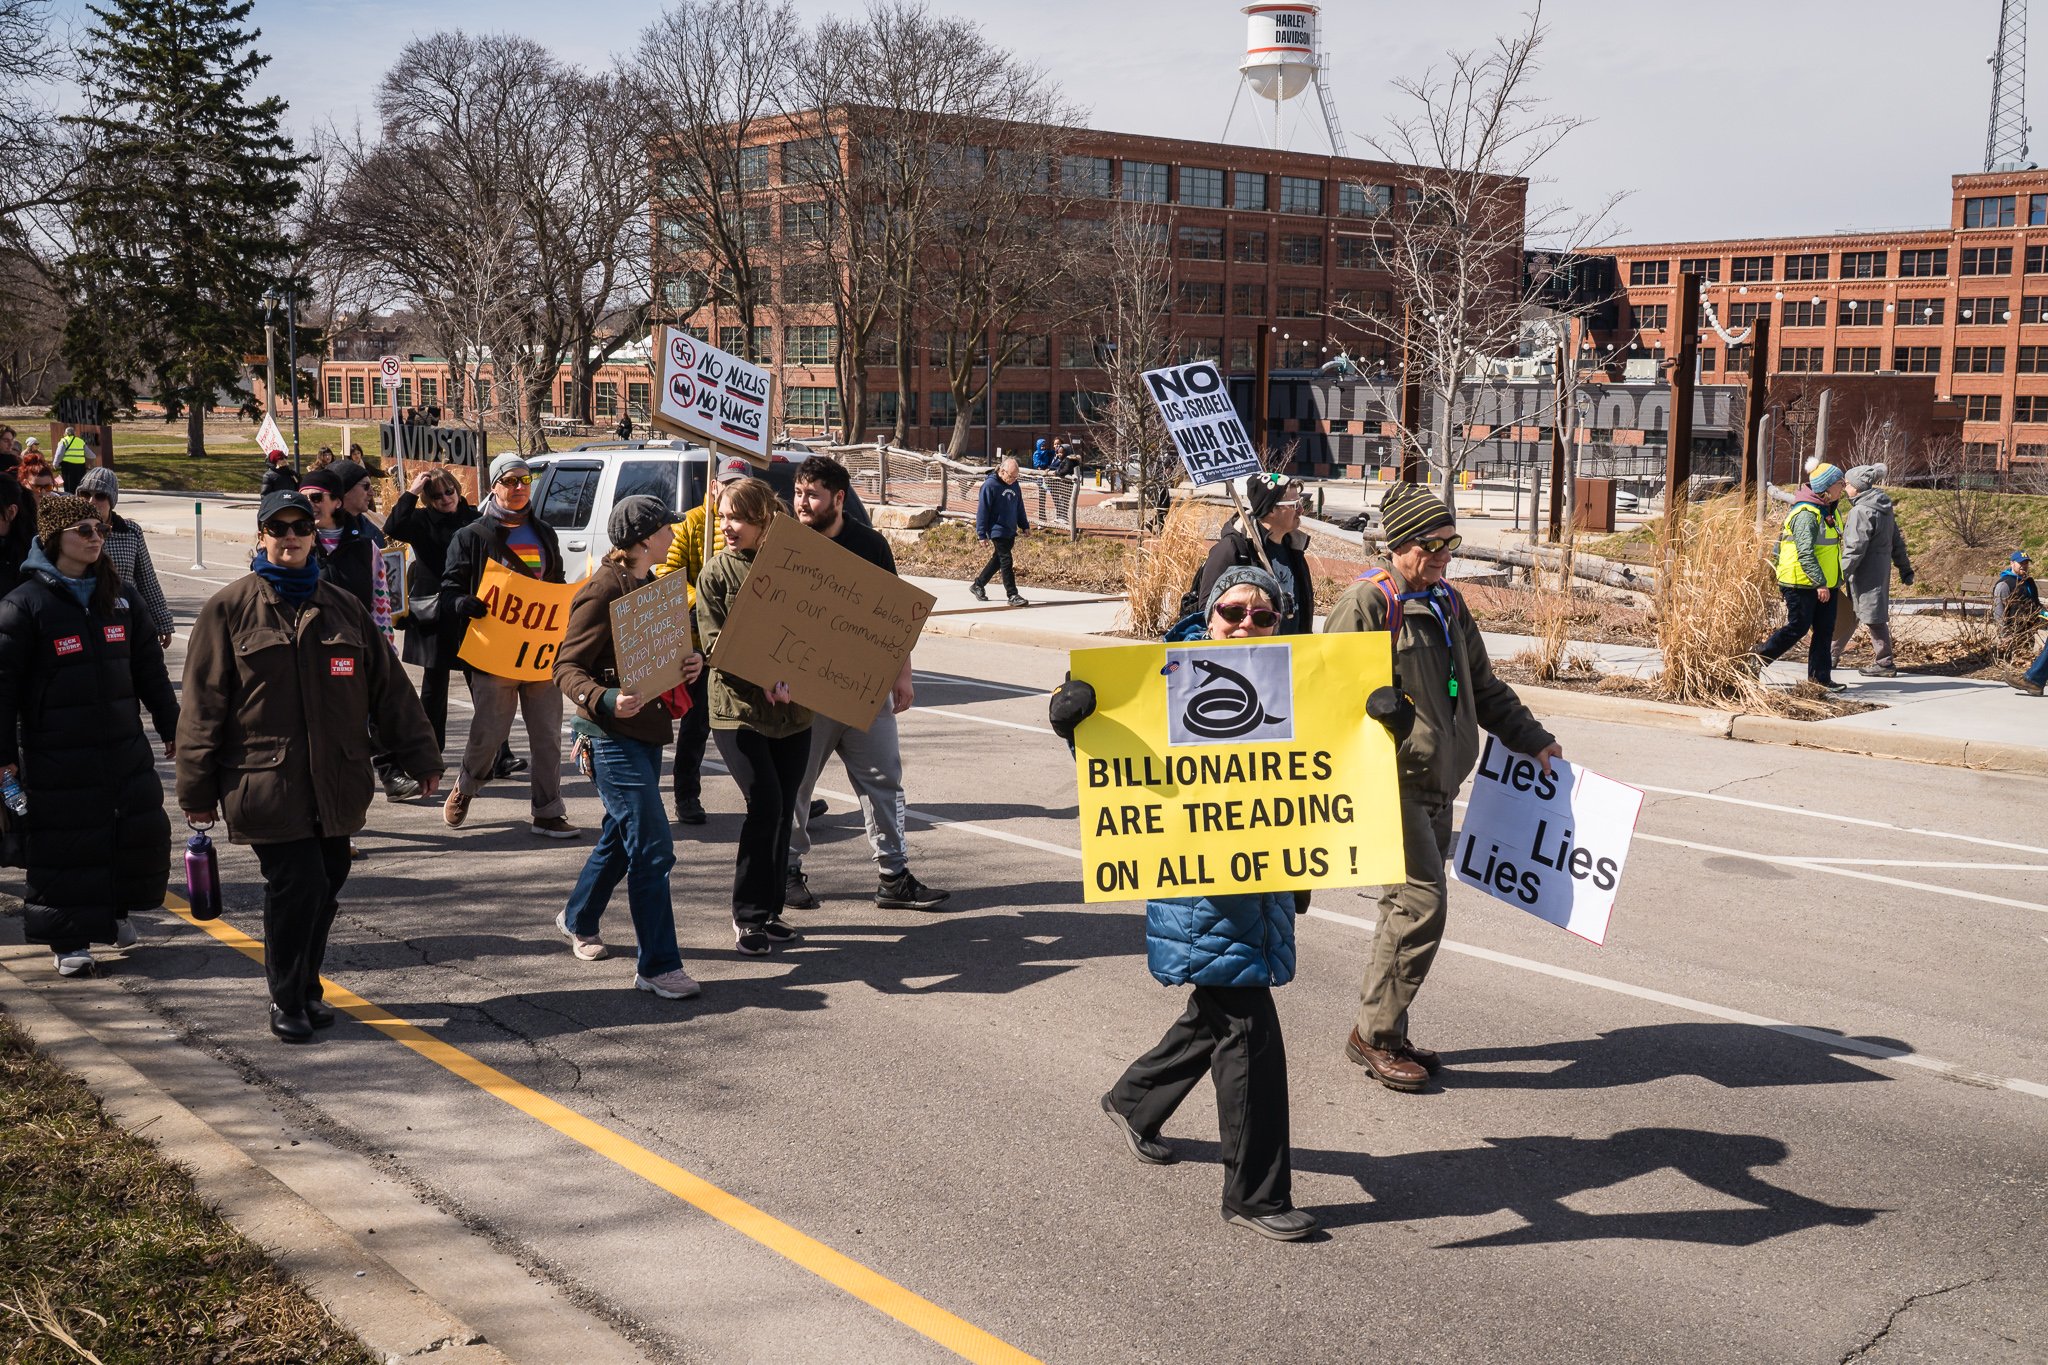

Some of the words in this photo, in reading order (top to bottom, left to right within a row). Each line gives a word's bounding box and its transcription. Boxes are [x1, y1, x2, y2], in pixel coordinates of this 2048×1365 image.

[1275, 14, 1307, 28] HARLEY-
[1275, 30, 1311, 45] DAVIDSON
[697, 352, 723, 379] NO
[725, 365, 769, 395] NAZIS
[1147, 364, 1220, 402] NO
[696, 387, 717, 411] NO
[719, 394, 761, 429] KINGS
[1161, 392, 1233, 423] US-ISRAELI
[380, 424, 486, 467] DAVIDSON
[1174, 424, 1221, 455] WAR
[1217, 419, 1246, 446] ON
[1186, 443, 1254, 472] IRAN!
[483, 584, 560, 631] ABOL
[615, 600, 631, 619] THE
[637, 587, 660, 607] ONLY
[665, 576, 682, 595] ICE
[618, 623, 629, 641] I
[633, 609, 654, 630] LIKE
[657, 602, 668, 615] IS
[670, 594, 683, 607] THE
[769, 588, 787, 604] in
[796, 599, 827, 621] our
[775, 547, 863, 605] Immigrants
[872, 595, 912, 648] belong
[515, 641, 563, 670] IC
[620, 633, 638, 654] ICE
[643, 616, 672, 640] THOSE
[769, 624, 816, 672] ICE
[625, 662, 653, 688] SKATE
[656, 653, 670, 669] ON
[1088, 750, 1333, 788] BILLIONAIRES
[1477, 735, 1560, 801] Lies
[1095, 804, 1164, 837] ARE
[1182, 793, 1354, 833] TREADING
[1096, 860, 1139, 892] ON
[1156, 854, 1215, 888] ALL
[1230, 851, 1270, 882] OF
[1282, 847, 1329, 878] US
[1460, 834, 1541, 905] Lies
[1530, 819, 1618, 891] Lies
